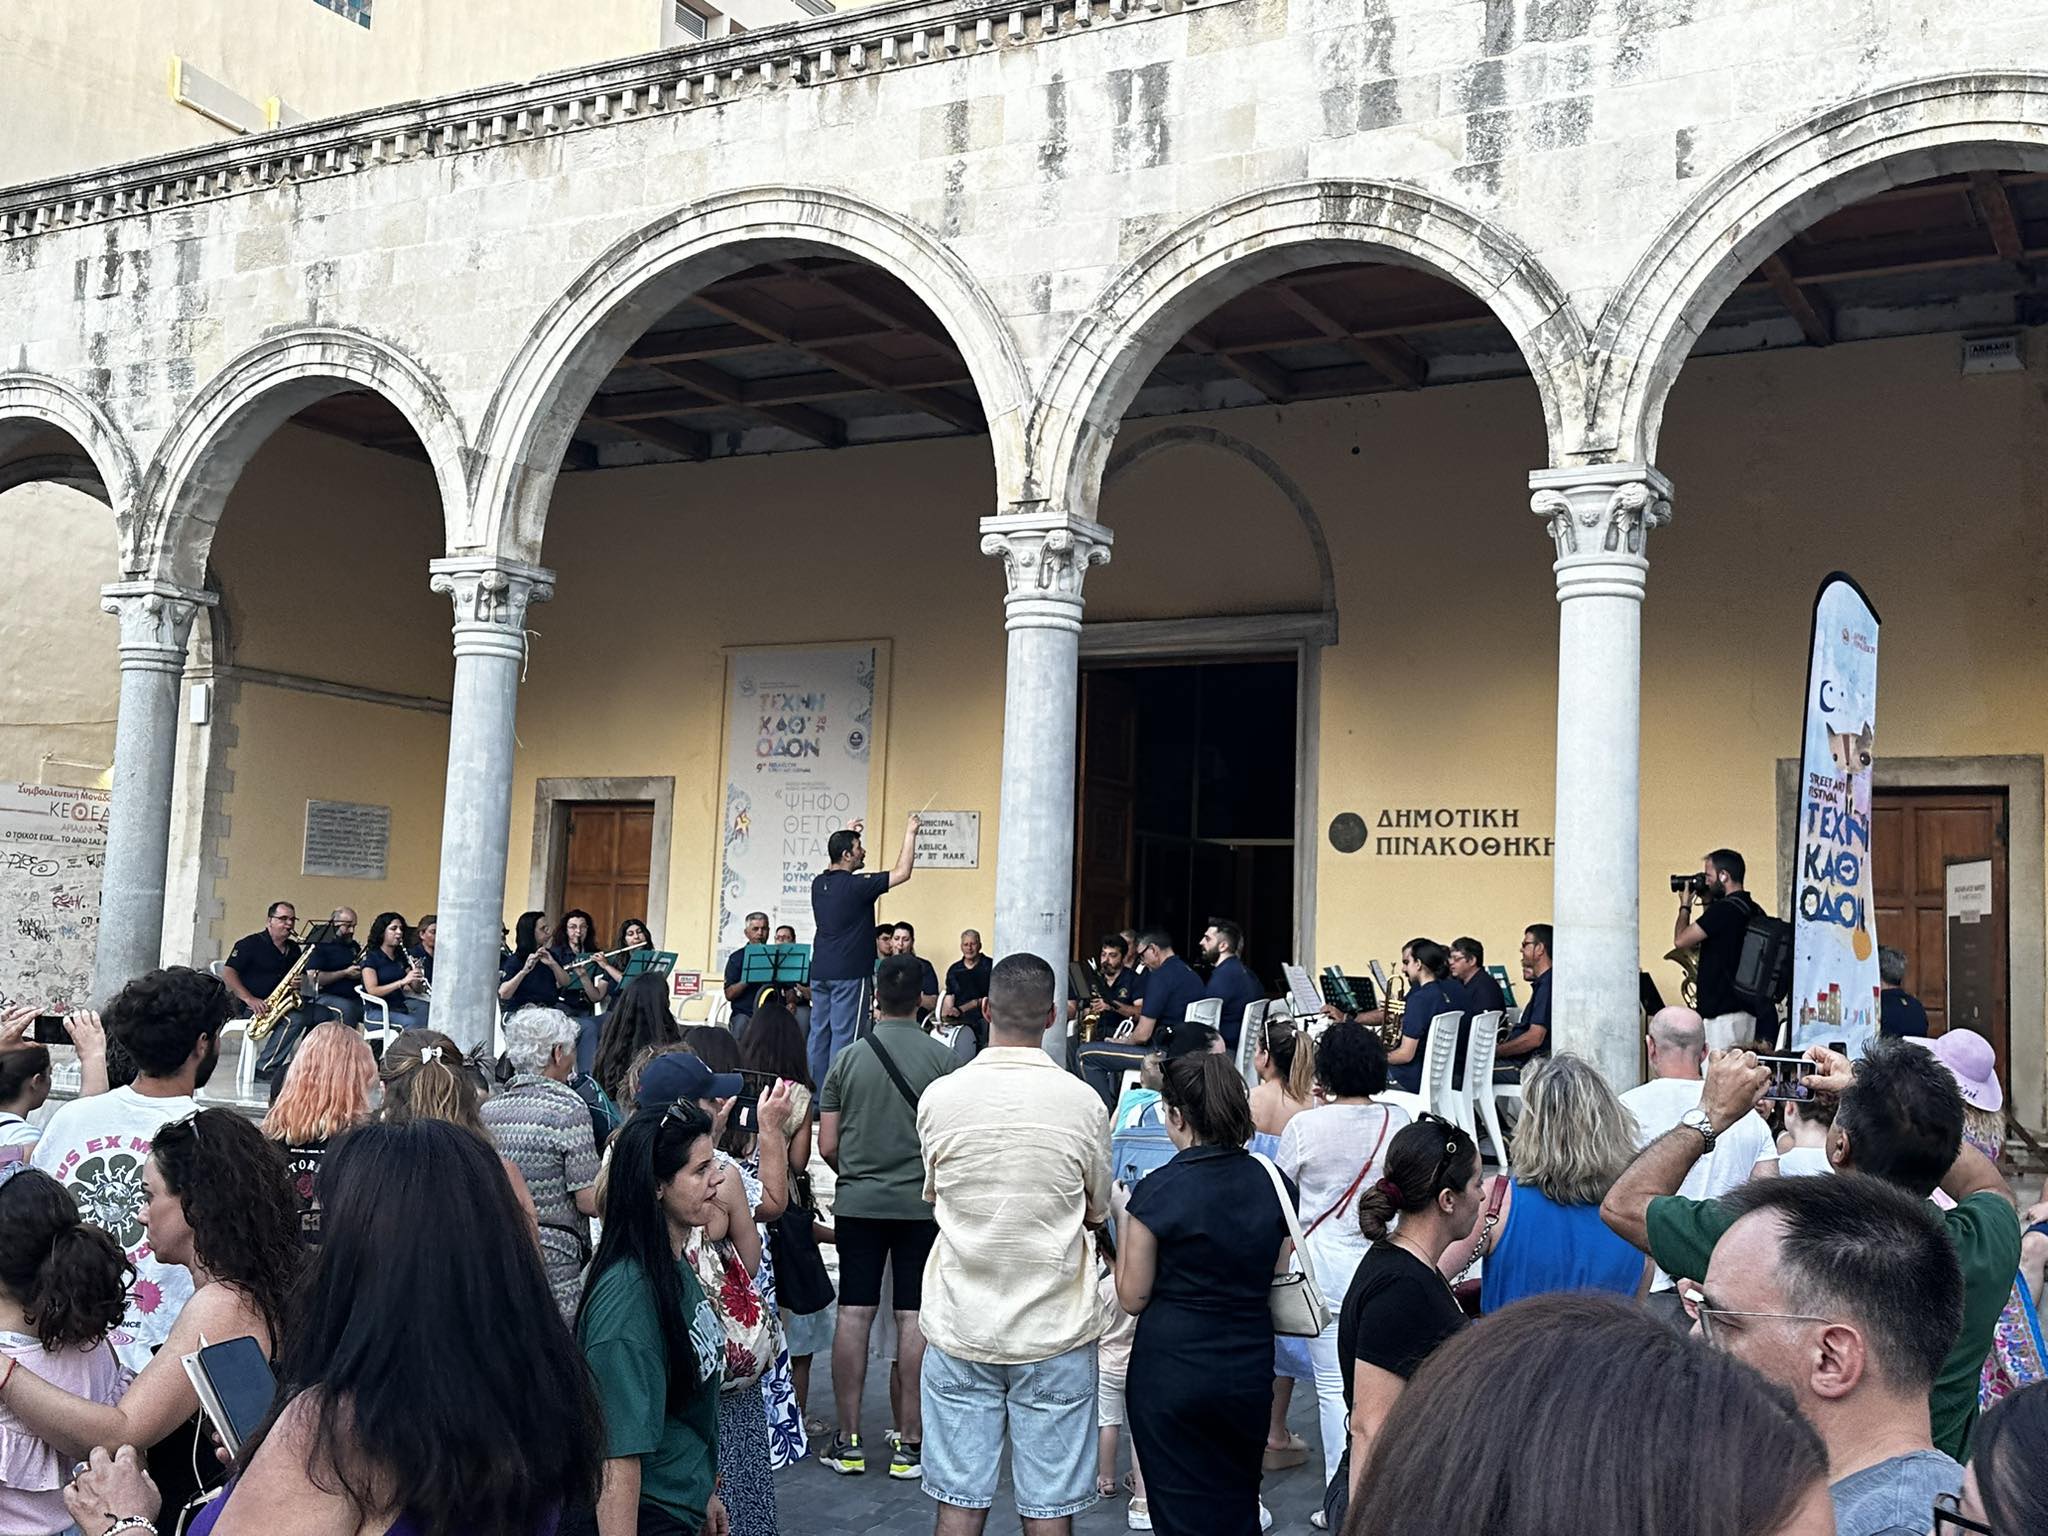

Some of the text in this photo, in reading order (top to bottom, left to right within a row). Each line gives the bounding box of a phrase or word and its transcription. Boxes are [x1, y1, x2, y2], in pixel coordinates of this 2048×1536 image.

[1809, 772, 1832, 788] STREET
[1376, 808, 1519, 828] ΔΗΜΟΤΙΚΗ
[86, 1136, 122, 1153] EX
